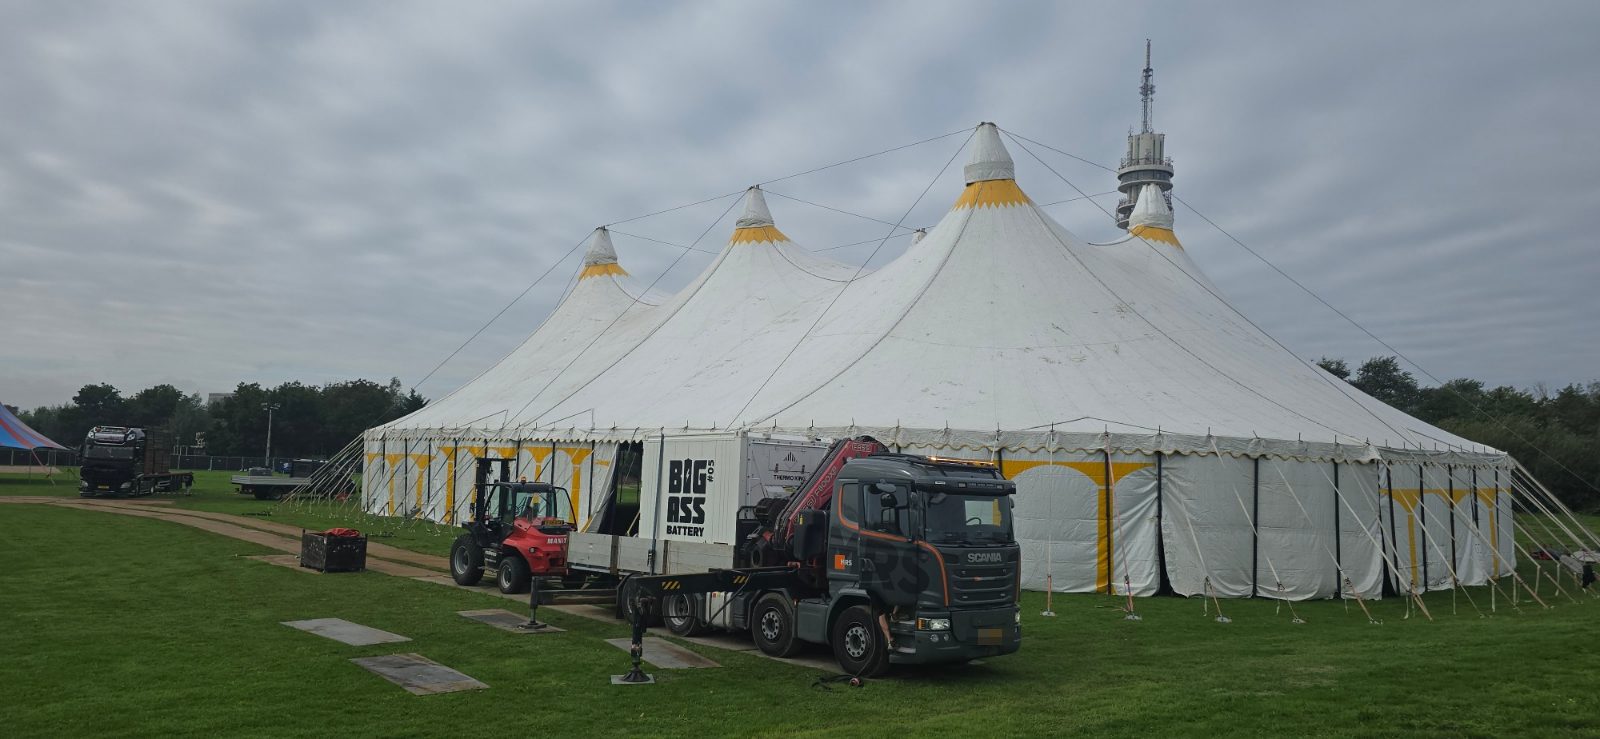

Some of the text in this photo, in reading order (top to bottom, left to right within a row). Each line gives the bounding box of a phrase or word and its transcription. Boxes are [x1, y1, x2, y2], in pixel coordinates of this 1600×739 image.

[669, 458, 707, 494] BIG
[707, 459, 715, 482] #05
[667, 496, 706, 524] ASS
[666, 525, 704, 537] BATTERY
[967, 552, 1002, 562] SCANIA
